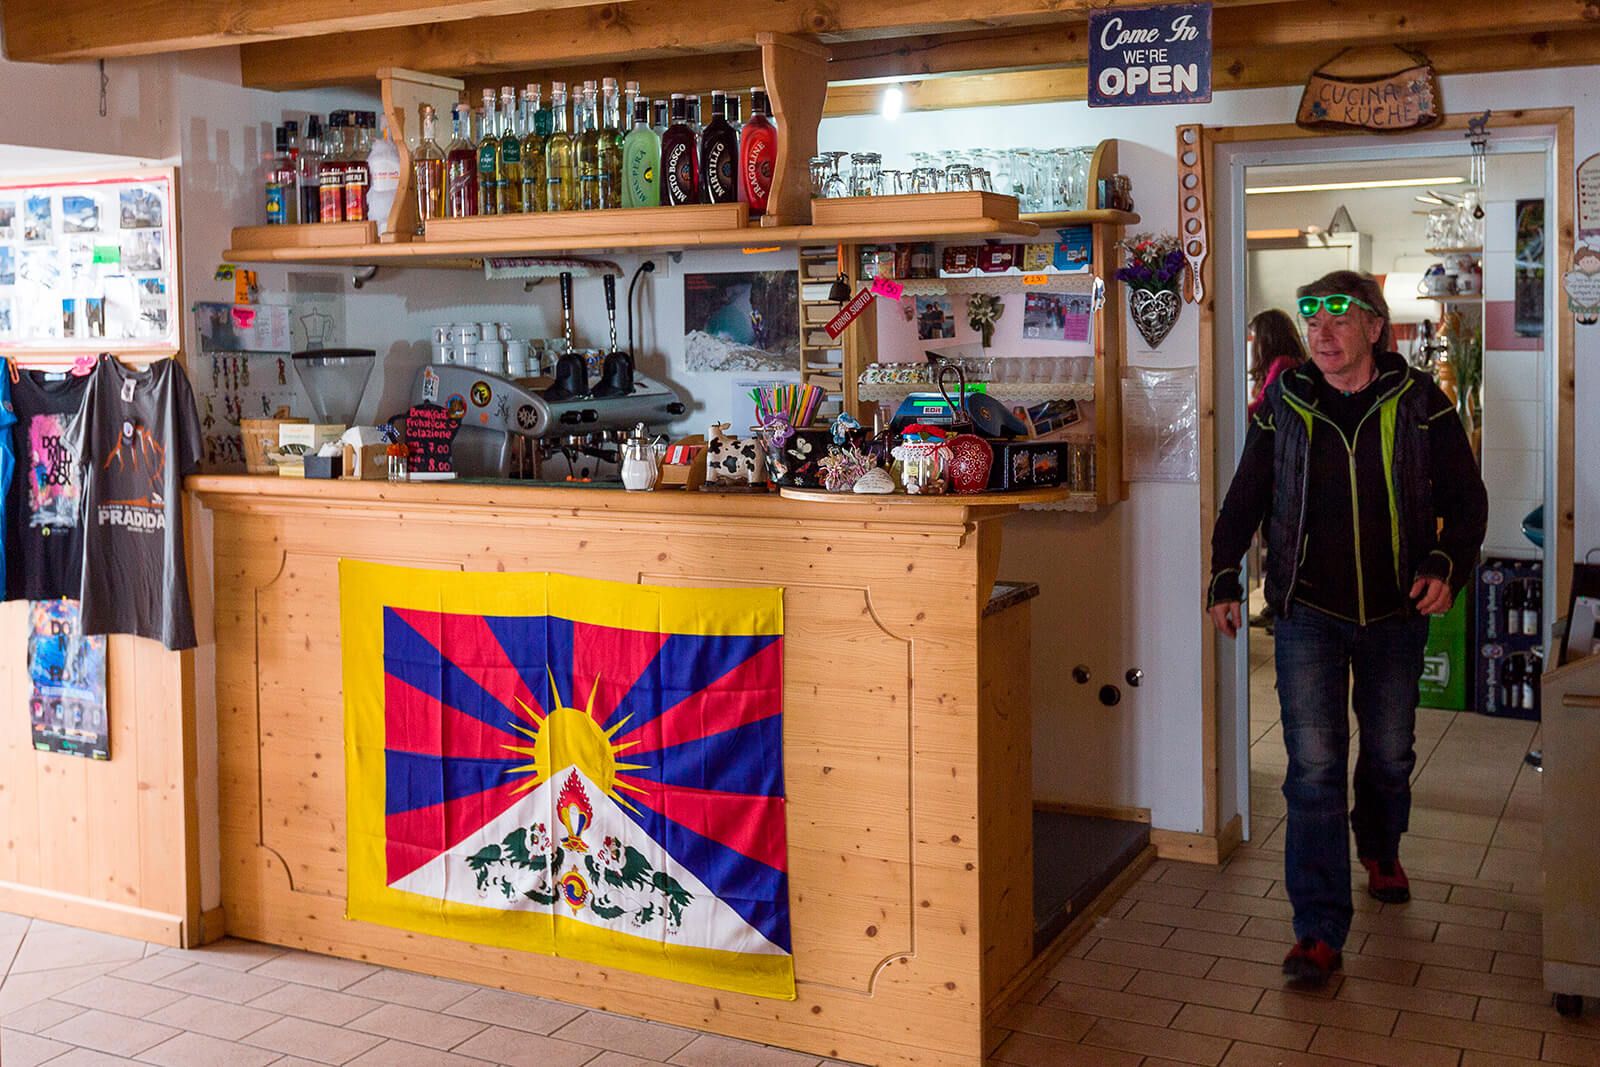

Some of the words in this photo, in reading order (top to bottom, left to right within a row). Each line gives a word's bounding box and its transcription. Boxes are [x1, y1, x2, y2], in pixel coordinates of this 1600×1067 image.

[1101, 17, 1159, 50] Come
[1165, 15, 1199, 42] In
[1123, 49, 1168, 64] WE'RE
[1098, 63, 1198, 96] OPEN
[1319, 83, 1398, 106] CUCINA
[668, 143, 686, 172] BOSCO
[708, 143, 725, 197] MIRTILLO
[748, 141, 766, 198] FRAGOLINE
[669, 175, 688, 202] MISTO
[830, 311, 852, 333] TORNO
[849, 292, 871, 315] SUBITO
[406, 428, 451, 439] Colazione
